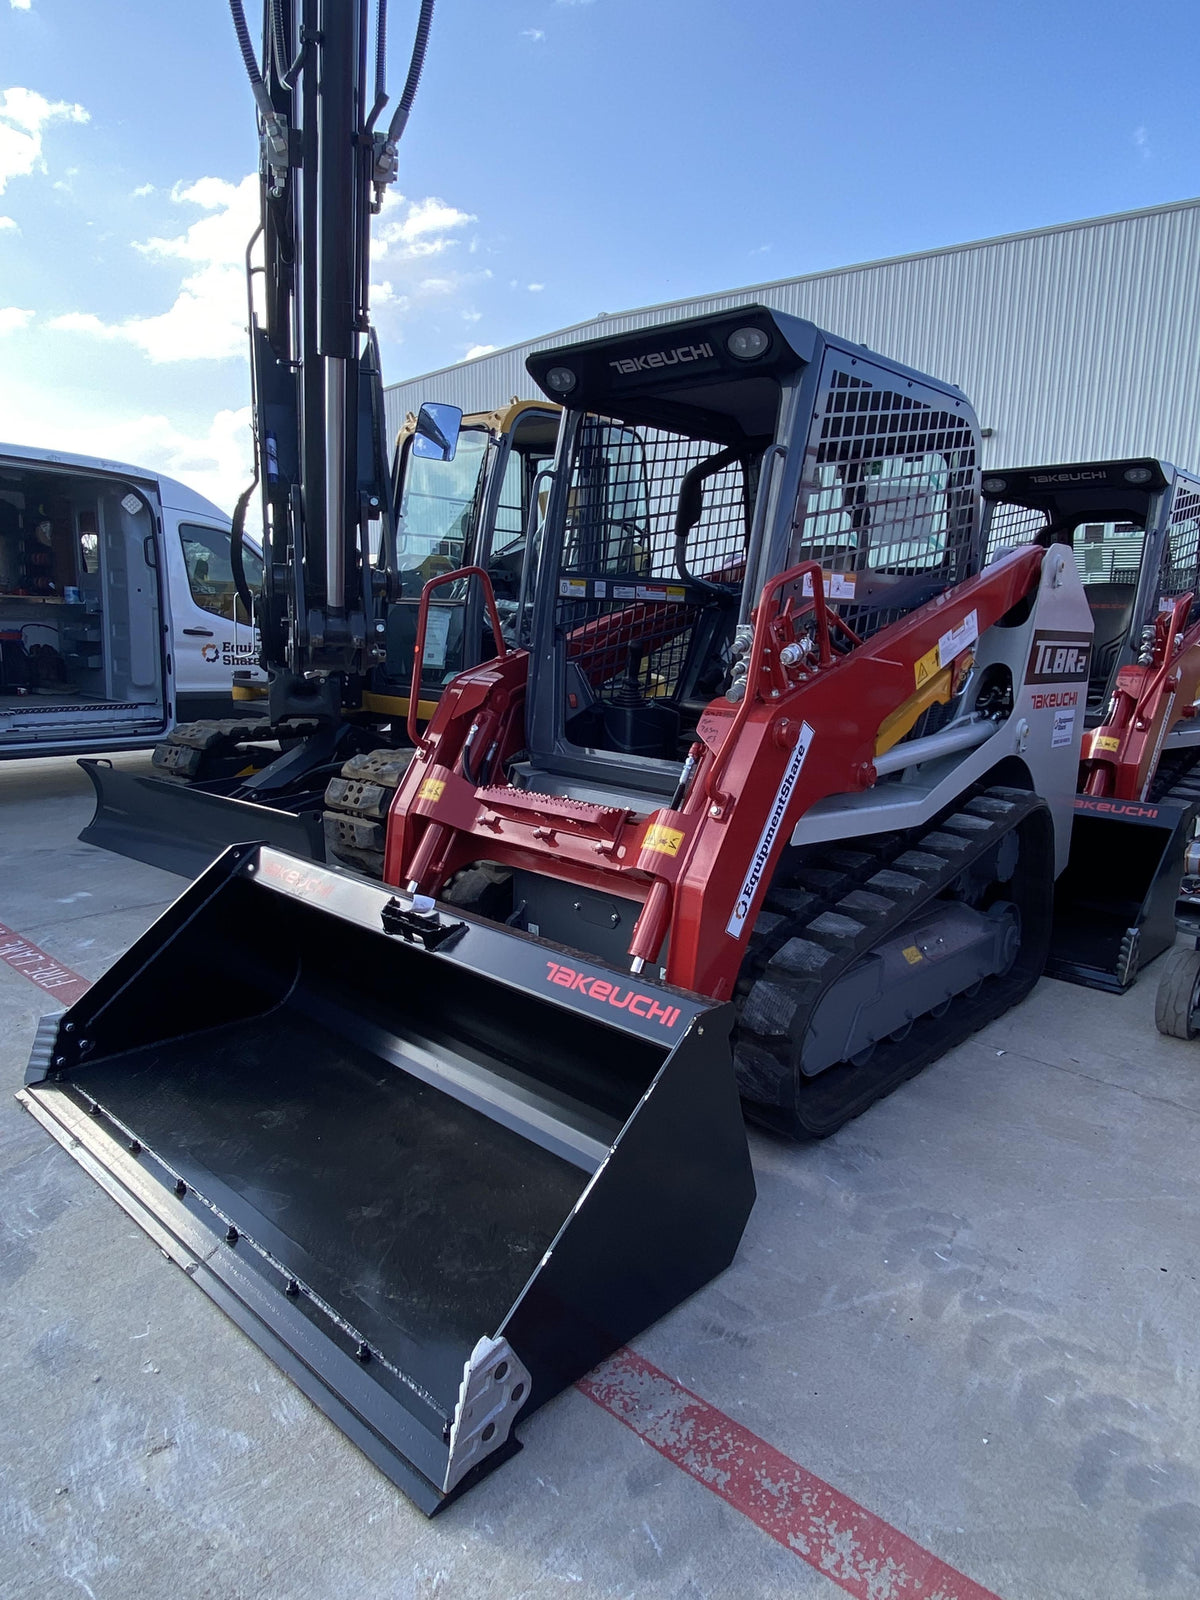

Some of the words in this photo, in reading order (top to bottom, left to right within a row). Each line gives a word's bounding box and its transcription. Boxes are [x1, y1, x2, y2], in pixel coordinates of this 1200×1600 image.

[1073, 799, 1158, 818] AKEUCHI
[743, 745, 805, 899] EquipmentShare
[23, 963, 77, 988] FIRE
